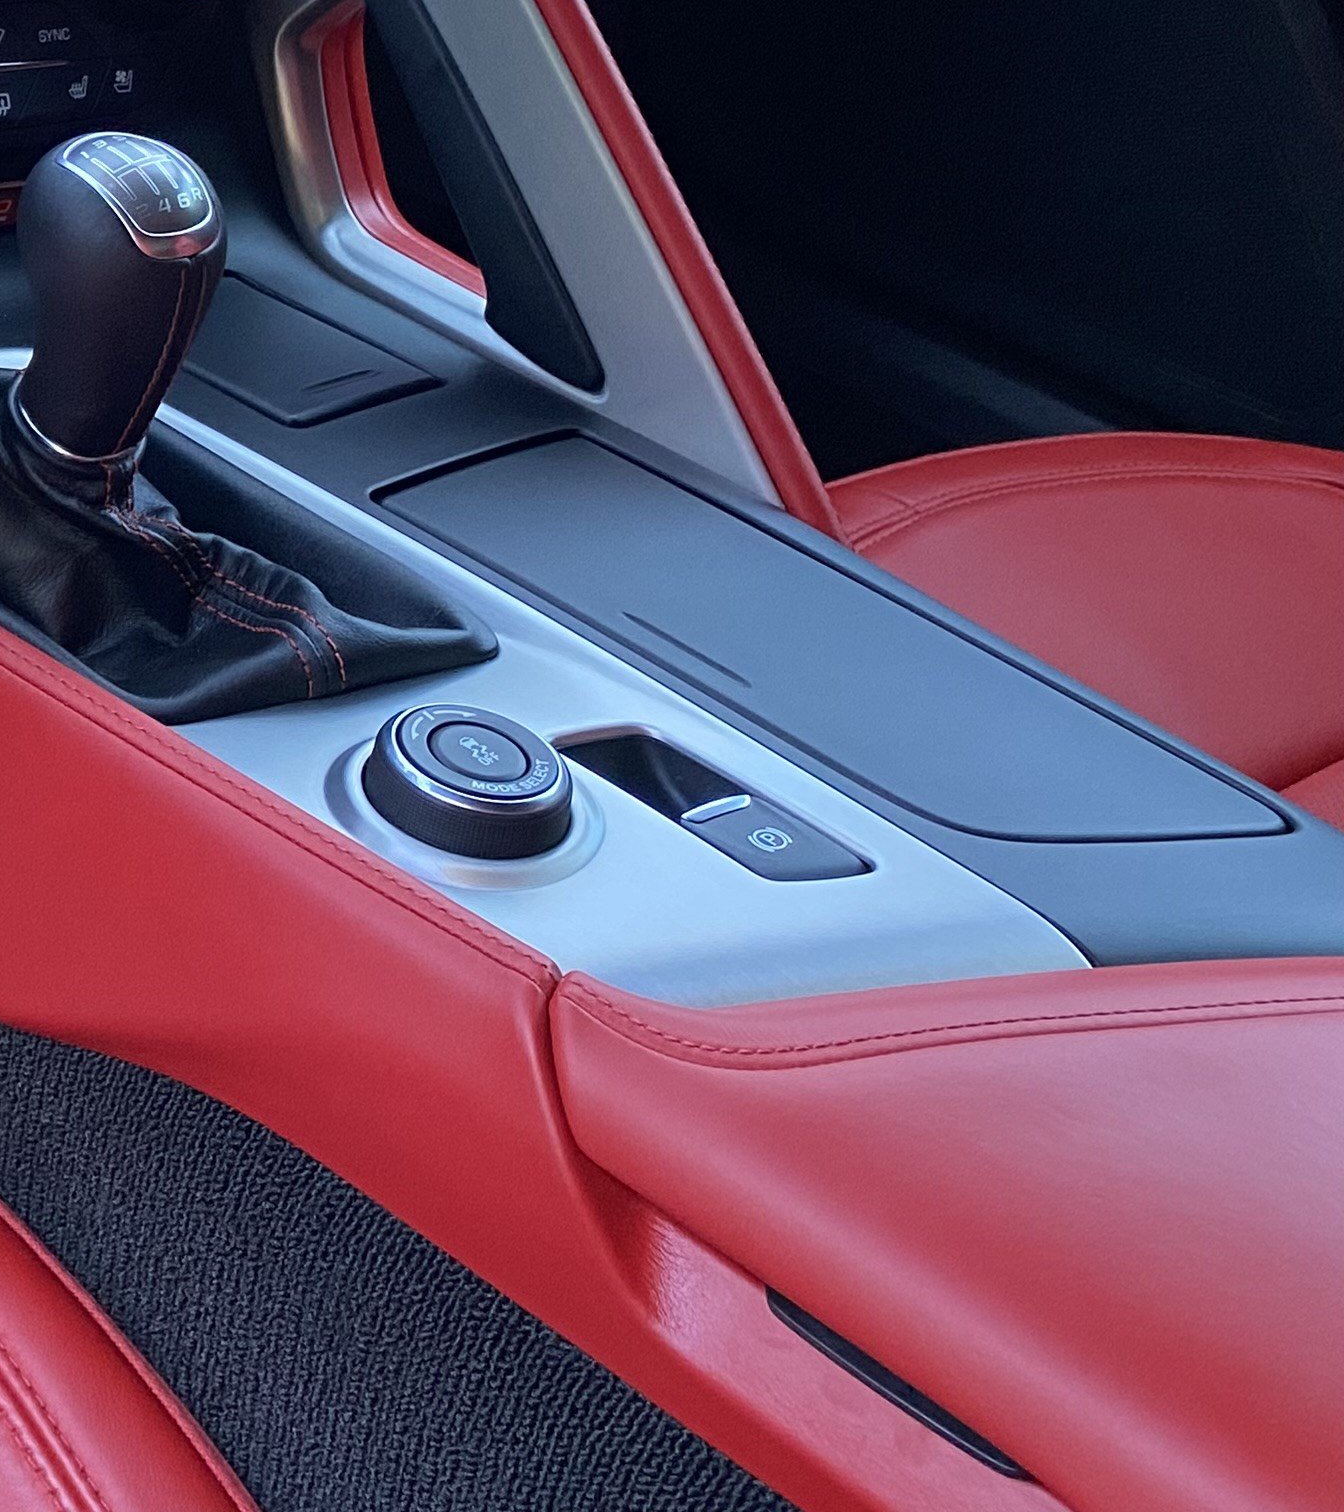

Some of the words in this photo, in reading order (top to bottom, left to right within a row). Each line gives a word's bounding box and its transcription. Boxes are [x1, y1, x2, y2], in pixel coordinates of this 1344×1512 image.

[38, 25, 71, 44] SYNC
[158, 199, 172, 213] 4
[176, 193, 191, 209] 6
[191, 187, 204, 201] R
[471, 779, 521, 793] MODE
[521, 758, 550, 790] SELECT
